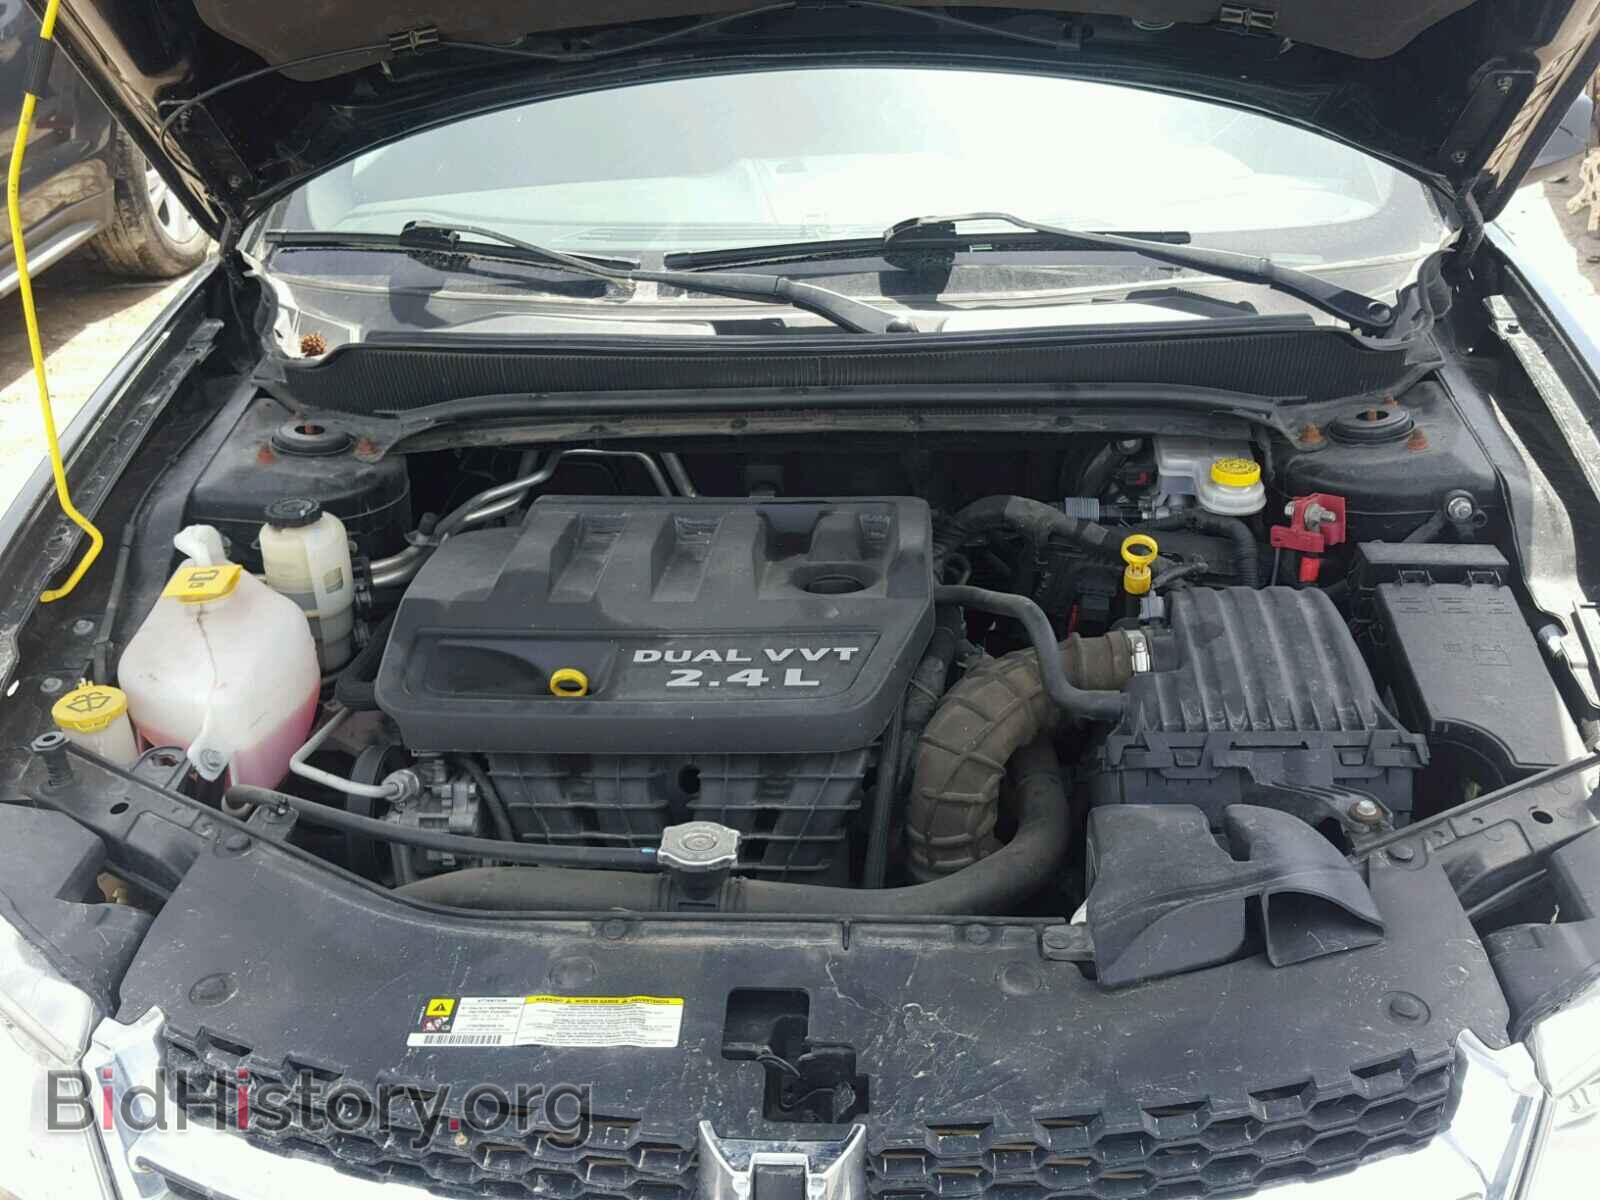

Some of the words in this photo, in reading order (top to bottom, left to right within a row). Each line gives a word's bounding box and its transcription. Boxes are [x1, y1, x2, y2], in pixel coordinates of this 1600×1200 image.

[633, 648, 752, 663] DUAL
[764, 647, 859, 662] VVT
[665, 668, 770, 687] 2.4
[783, 668, 820, 686] L
